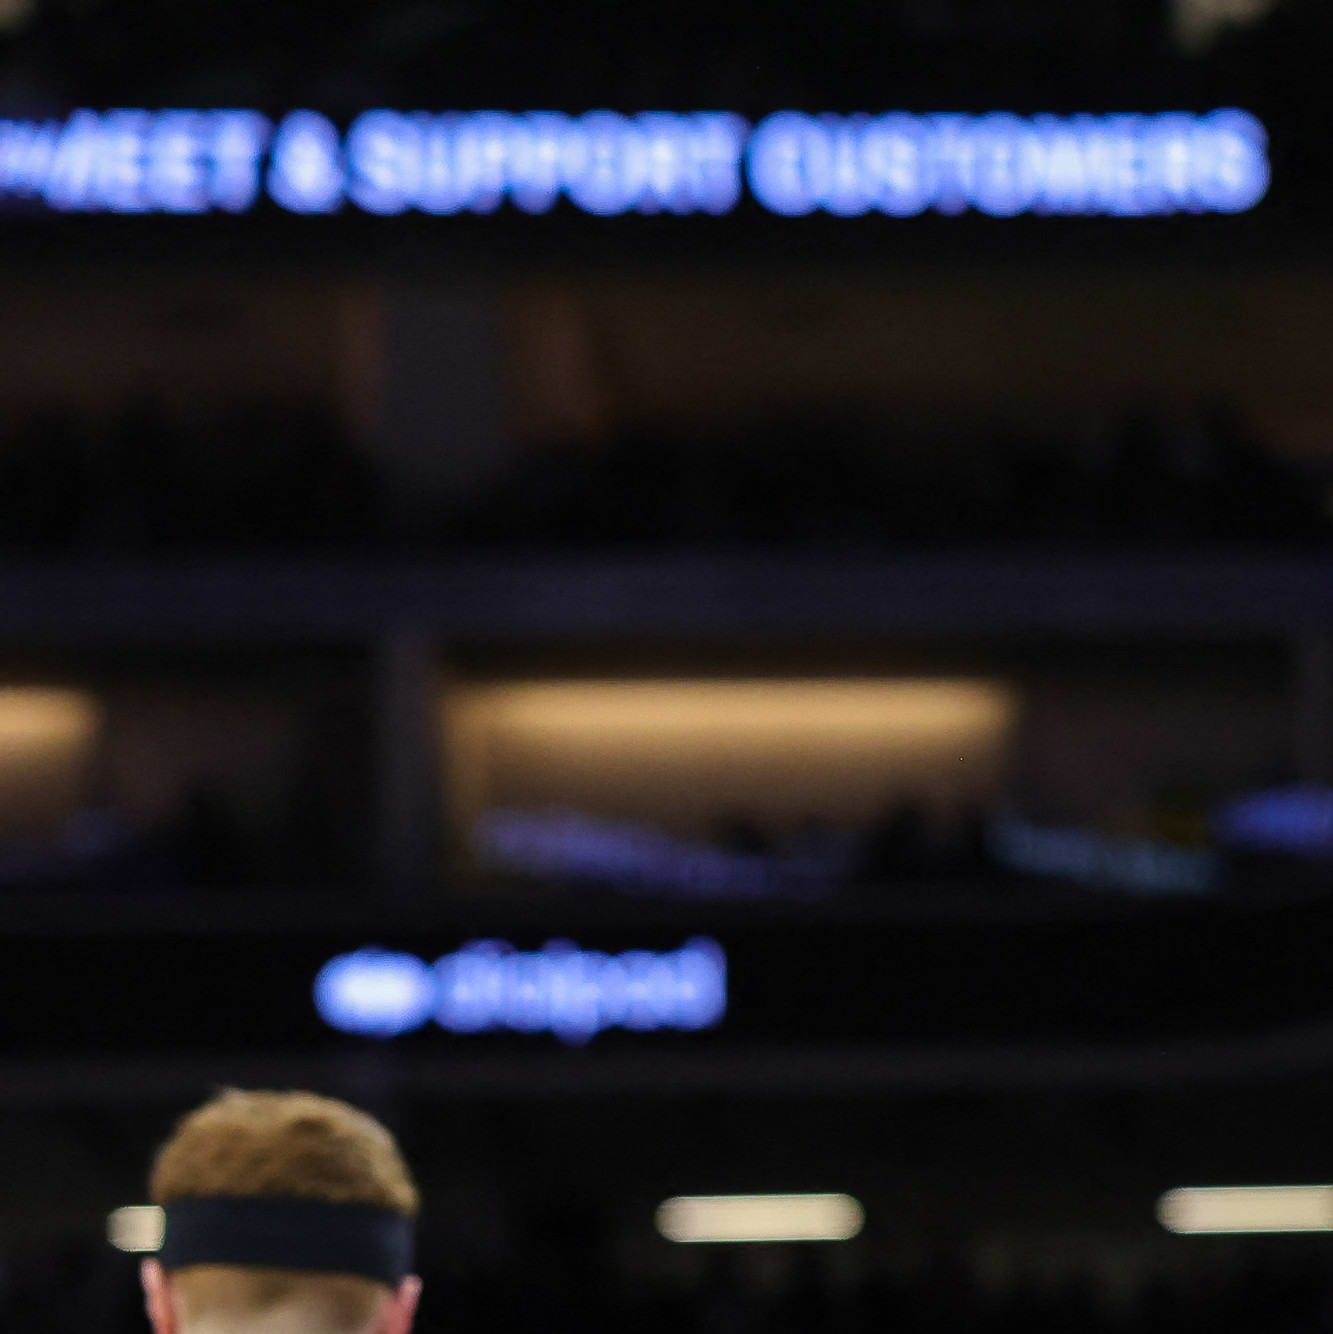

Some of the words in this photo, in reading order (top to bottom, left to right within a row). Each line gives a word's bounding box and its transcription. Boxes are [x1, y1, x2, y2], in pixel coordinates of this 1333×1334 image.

[50, 108, 270, 214] MEET
[269, 109, 344, 213] &
[346, 109, 746, 216] SUPPORT
[747, 107, 1269, 216] CUSTOMERS
